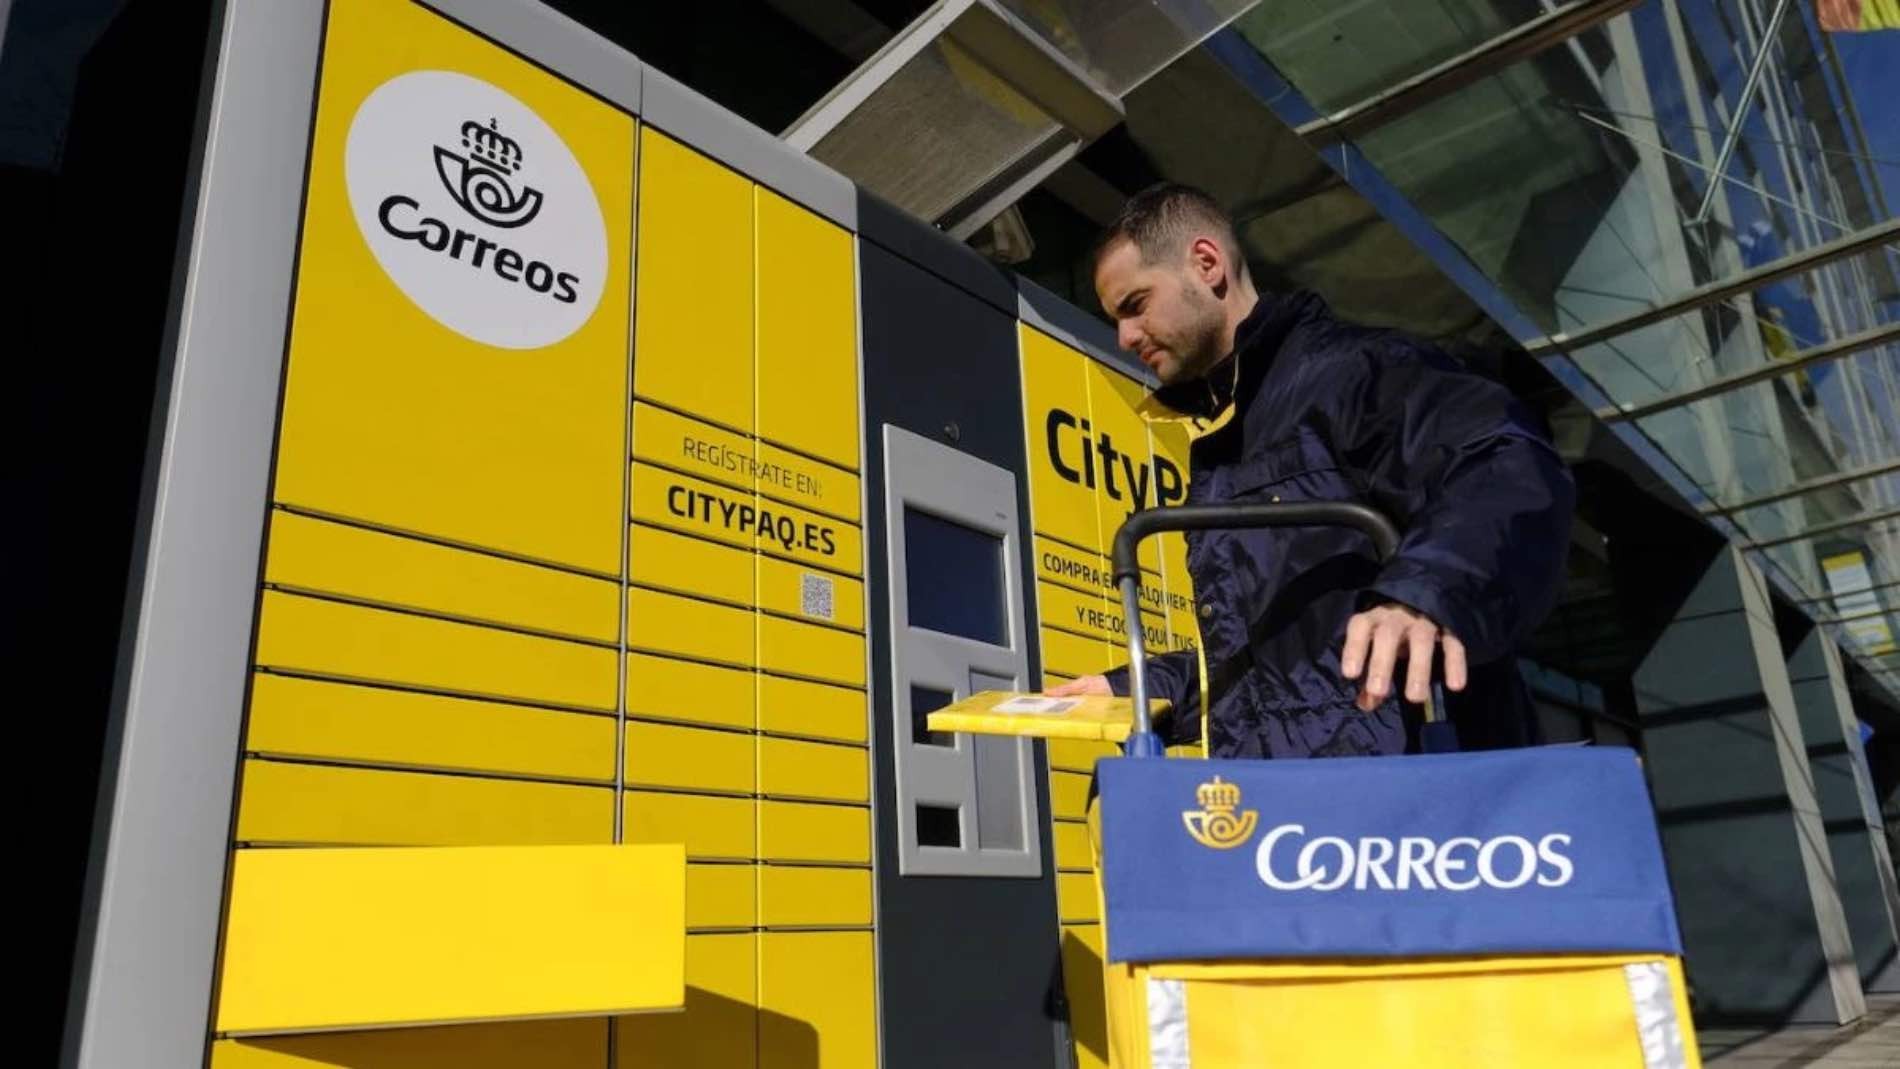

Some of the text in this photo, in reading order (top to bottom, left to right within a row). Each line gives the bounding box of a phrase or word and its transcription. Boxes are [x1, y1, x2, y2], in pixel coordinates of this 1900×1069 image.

[378, 194, 580, 304] Correos
[683, 436, 823, 499] REGÍSTRATE EN:
[1046, 408, 1190, 518] CityP
[668, 485, 836, 555] CITYPAQ.ES
[1043, 553, 1100, 585] COMPRA
[1137, 584, 1187, 611] ALQUIER
[1076, 606, 1084, 623] Y
[1088, 608, 1126, 635] RECO
[1256, 824, 1574, 890] CORREOS
